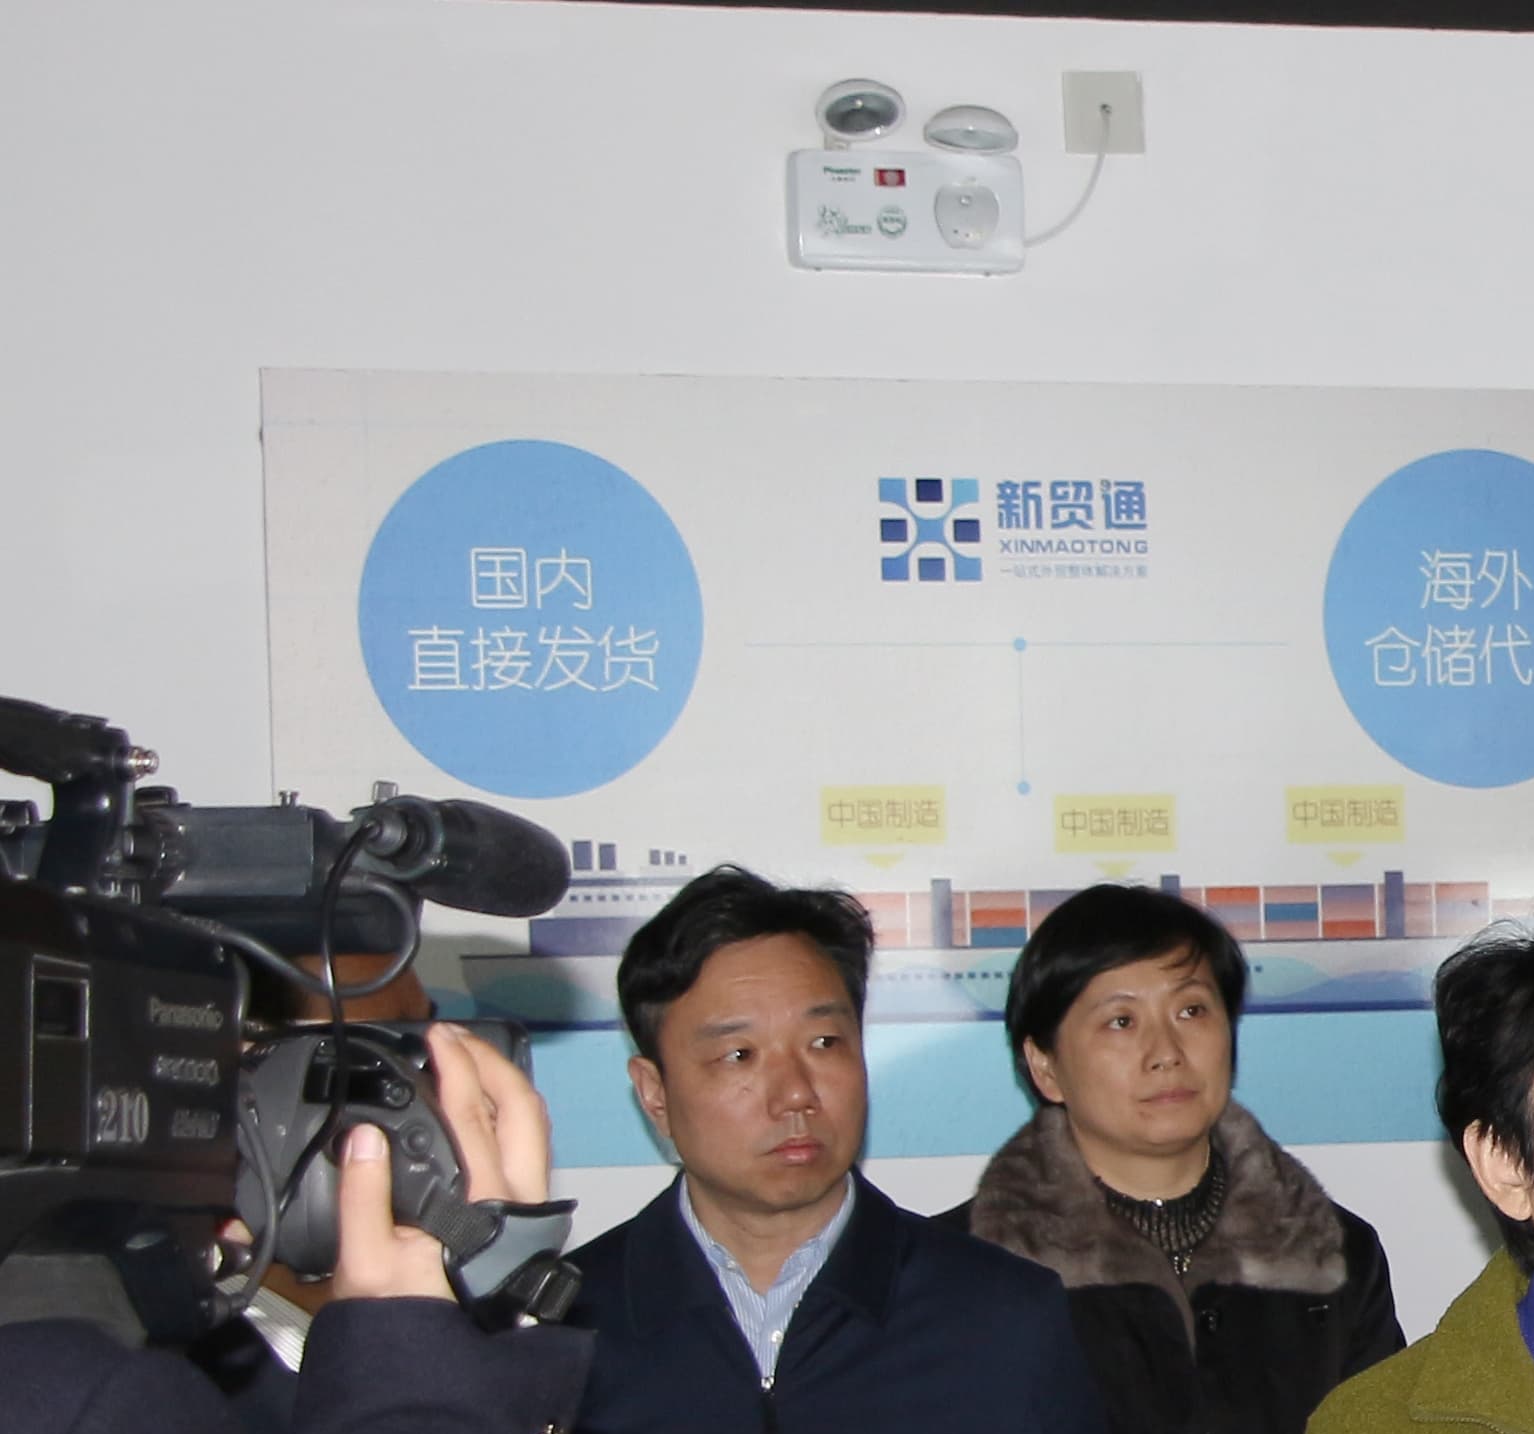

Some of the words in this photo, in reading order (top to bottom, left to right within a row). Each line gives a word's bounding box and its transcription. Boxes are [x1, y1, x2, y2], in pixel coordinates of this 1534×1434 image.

[996, 479, 1148, 530] 新贸通
[1000, 539, 1148, 554] XINMAOTONG
[470, 548, 593, 609] 国内
[1419, 549, 1534, 610] 海外
[407, 625, 660, 692] 直接发货
[827, 798, 941, 830] 中国制造
[1060, 807, 1170, 838] 中国制造
[1292, 799, 1399, 829] 中国制造
[150, 997, 223, 1032] Panasonic
